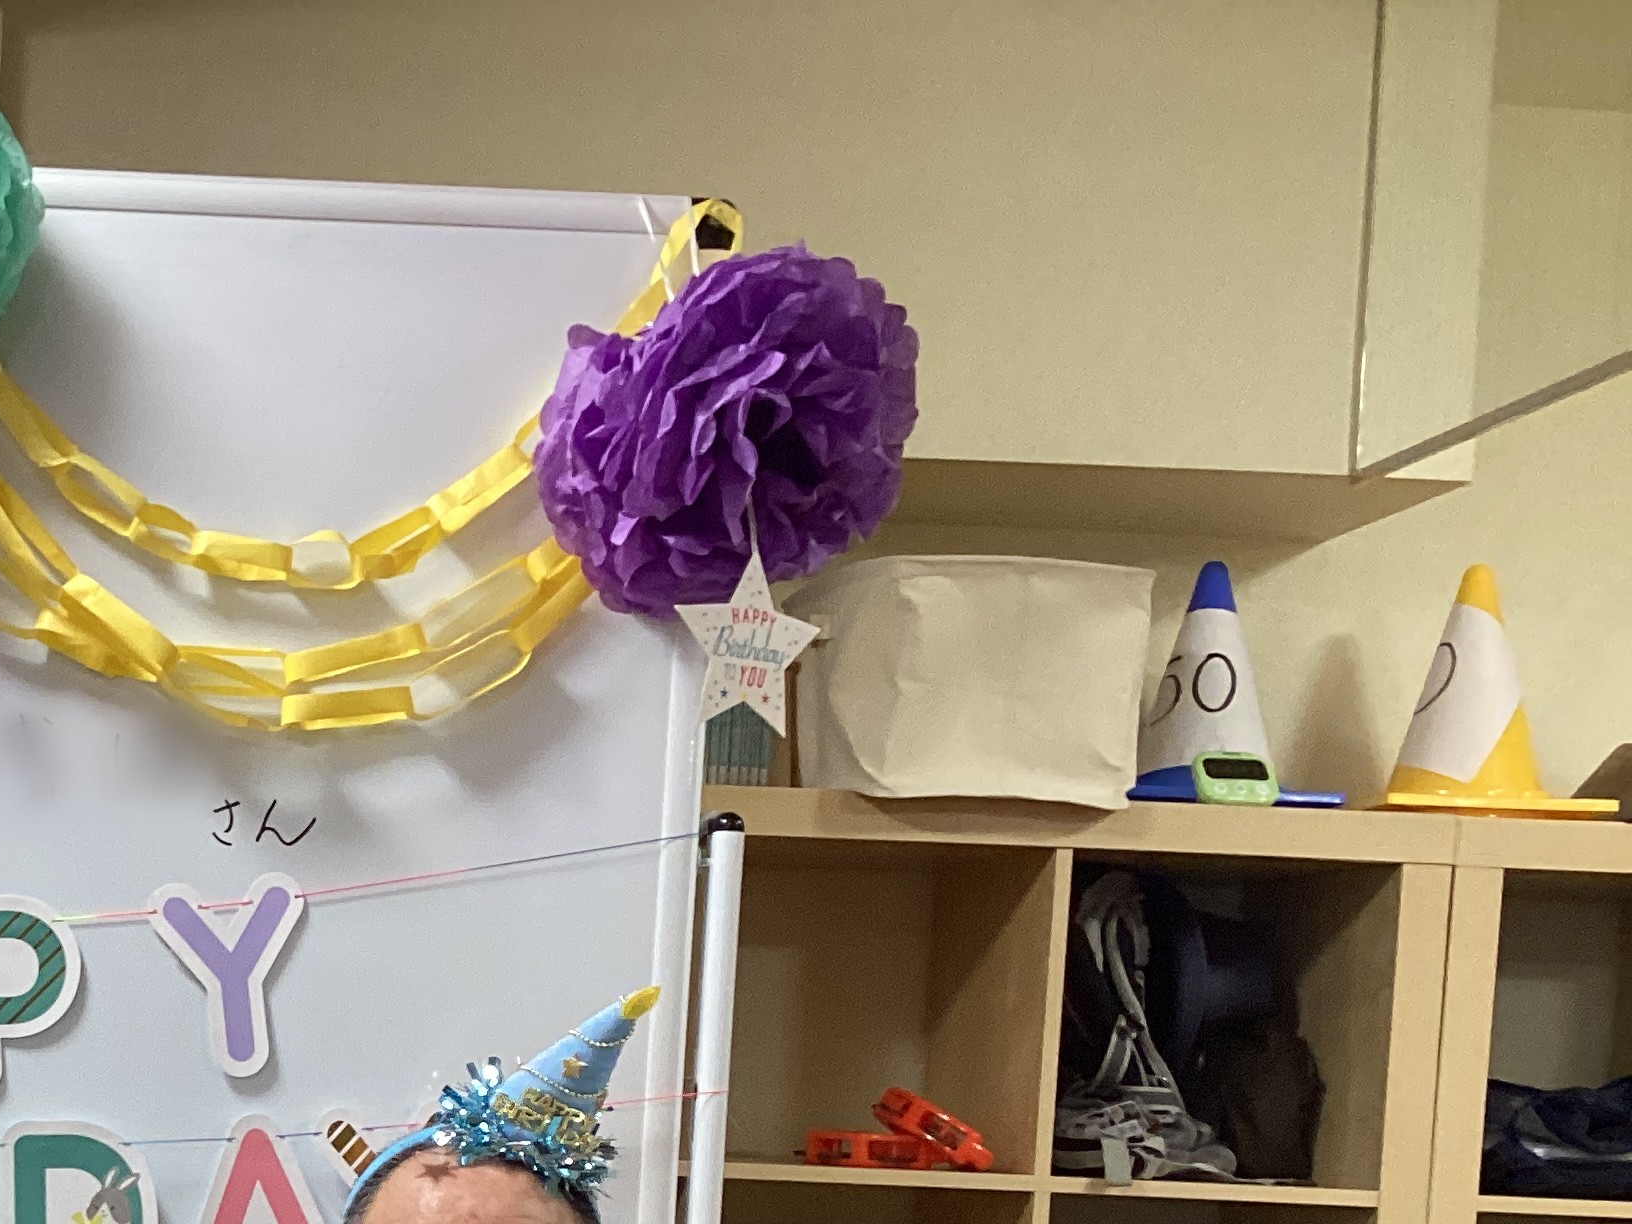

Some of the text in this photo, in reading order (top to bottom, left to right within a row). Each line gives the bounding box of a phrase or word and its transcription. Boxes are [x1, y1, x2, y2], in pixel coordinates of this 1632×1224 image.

[731, 607, 777, 628] HAPPY
[713, 625, 790, 672] Birthday
[739, 665, 768, 689] YOU
[211, 798, 317, 846] さん
